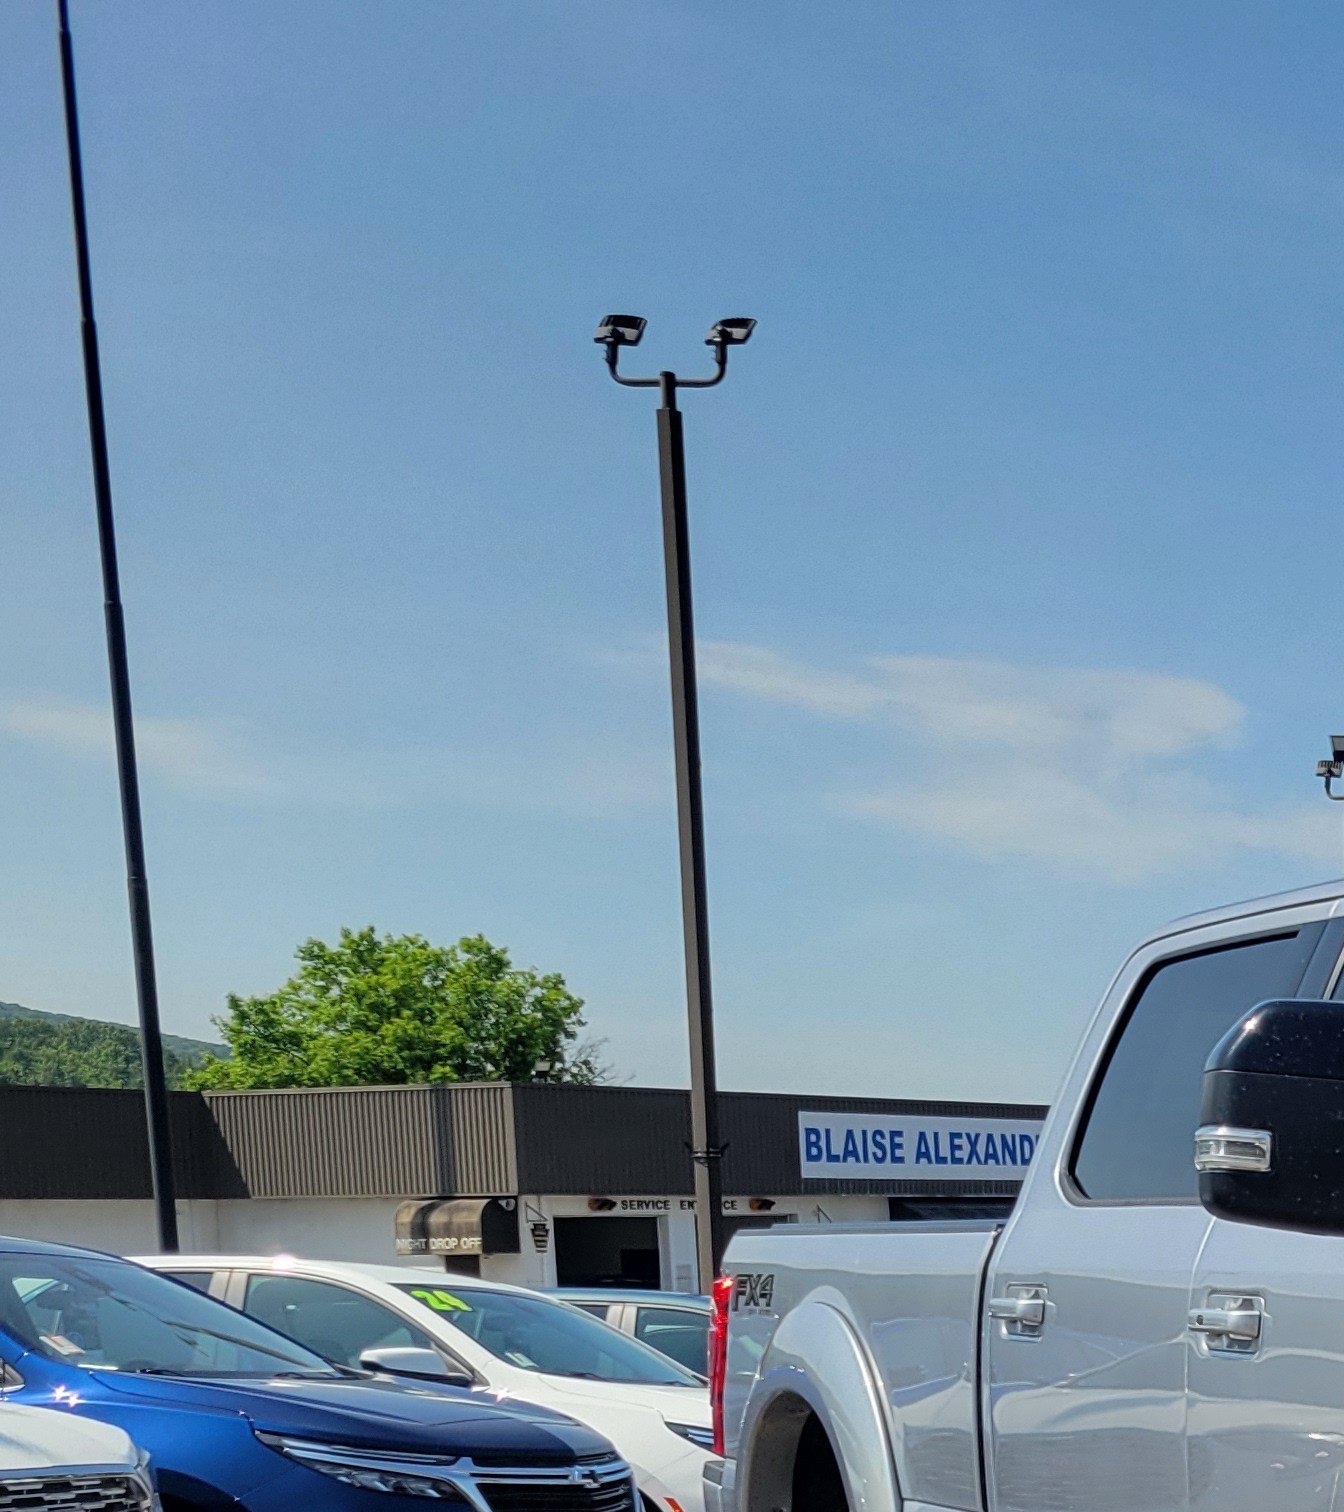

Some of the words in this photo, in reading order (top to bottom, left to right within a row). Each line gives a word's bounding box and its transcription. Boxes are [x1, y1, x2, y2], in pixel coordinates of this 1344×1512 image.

[804, 1127, 905, 1165] BLAISE
[915, 1131, 1040, 1166] ALEXAND
[621, 1199, 670, 1211] SERVICE
[396, 1238, 427, 1250] NIGHT
[429, 1237, 457, 1250] DROP
[460, 1237, 483, 1250] OFF
[731, 1273, 775, 1312] FX4
